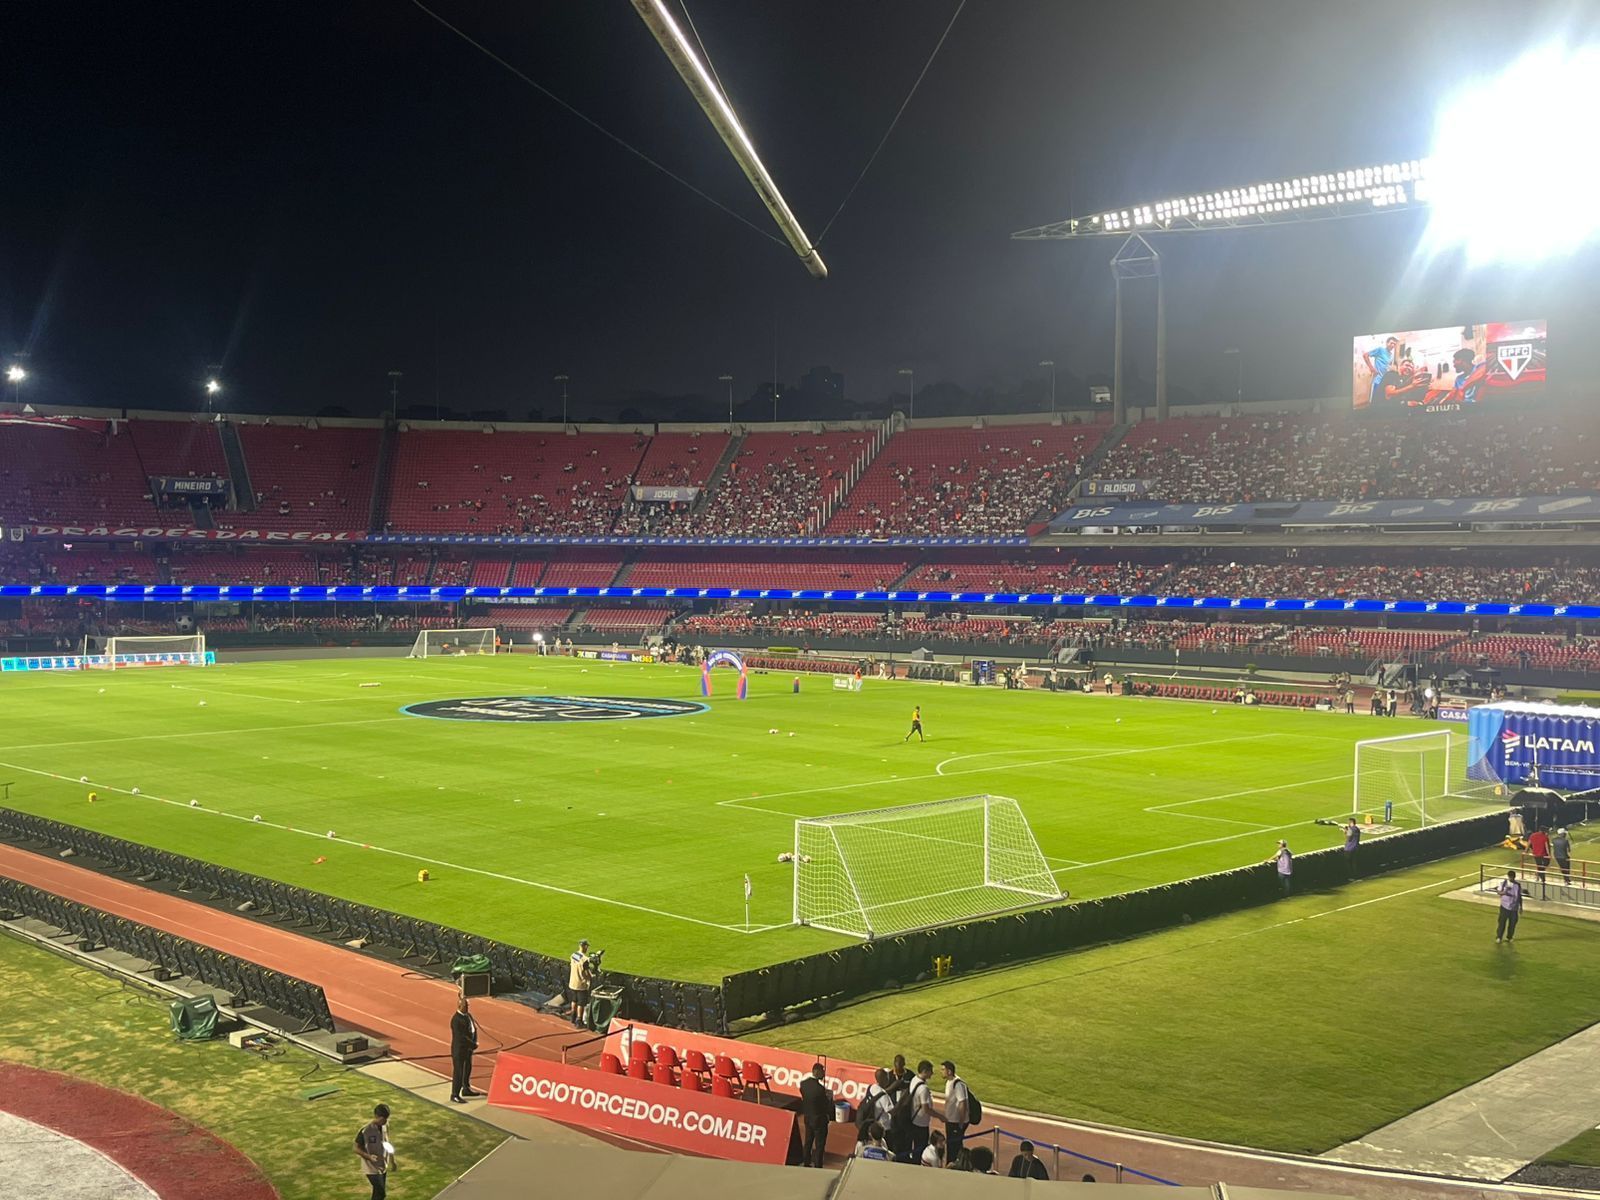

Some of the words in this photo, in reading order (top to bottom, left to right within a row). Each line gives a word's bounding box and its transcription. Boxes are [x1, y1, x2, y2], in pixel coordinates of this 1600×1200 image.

[1501, 347, 1529, 357] SPFC
[160, 479, 166, 490] 7
[174, 481, 211, 490] MINEIRO
[1089, 482, 1097, 494] 9
[215, 529, 259, 539] DA
[266, 531, 349, 540] REAL
[1525, 735, 1594, 754] LATAM
[509, 1073, 767, 1146] SOCIOTORCEDOR.COM.BR
